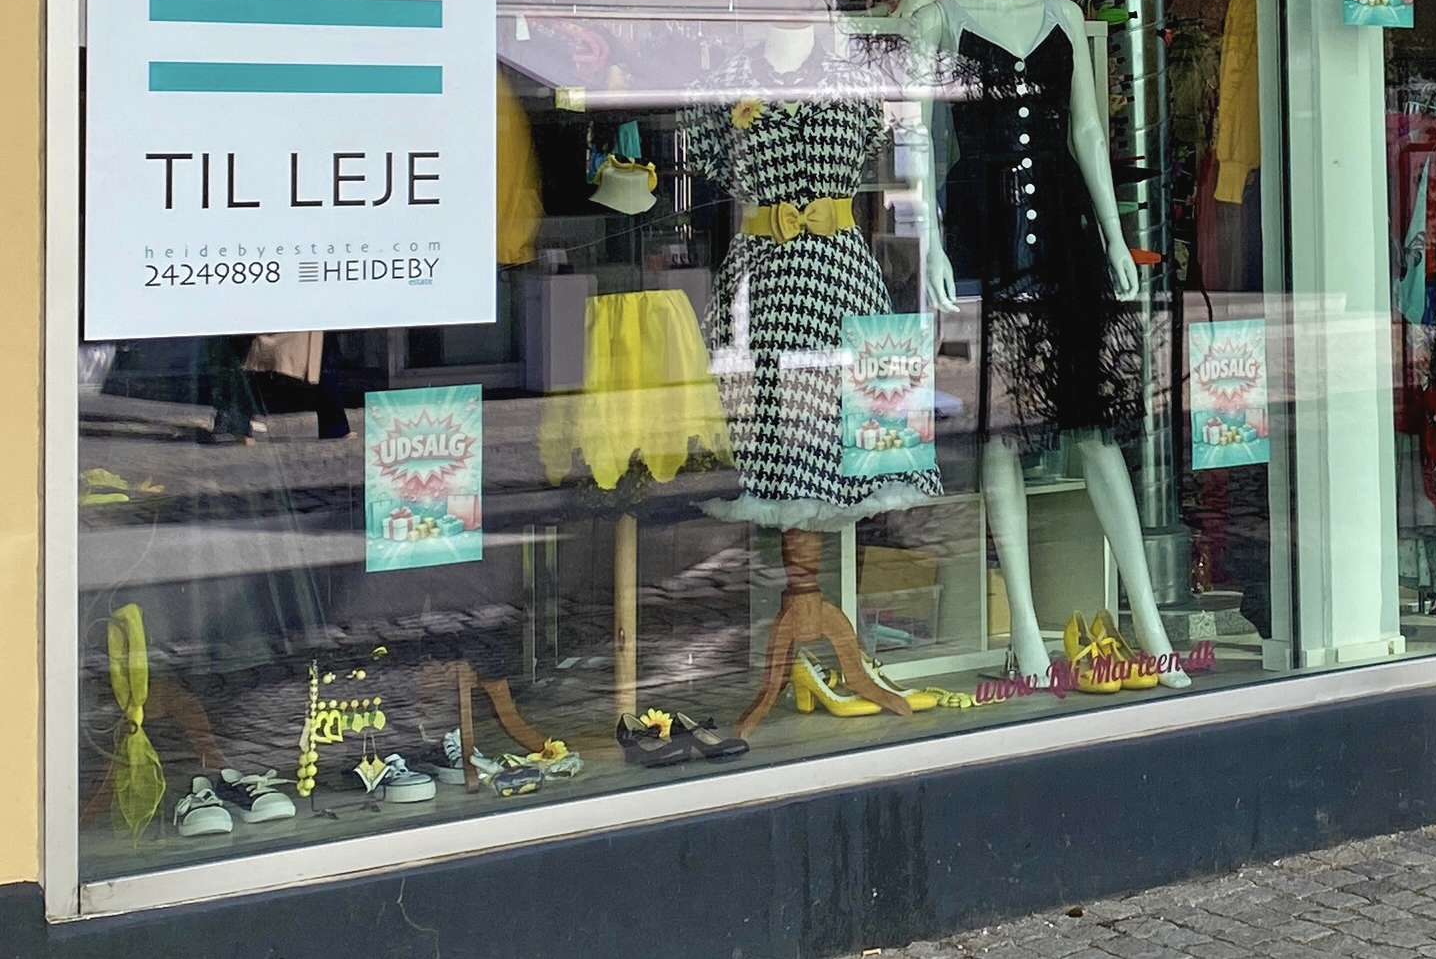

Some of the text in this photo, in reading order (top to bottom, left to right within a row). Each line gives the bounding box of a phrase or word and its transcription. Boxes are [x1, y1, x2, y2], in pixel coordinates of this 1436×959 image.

[145, 151, 441, 210] TIL LEJE
[145, 240, 441, 260] heidebyestate.com
[144, 257, 440, 287] 24249898 HEIDEBY
[853, 354, 923, 381] UDSALG
[1200, 357, 1257, 382] UDSALG
[380, 432, 468, 465] UDSALG
